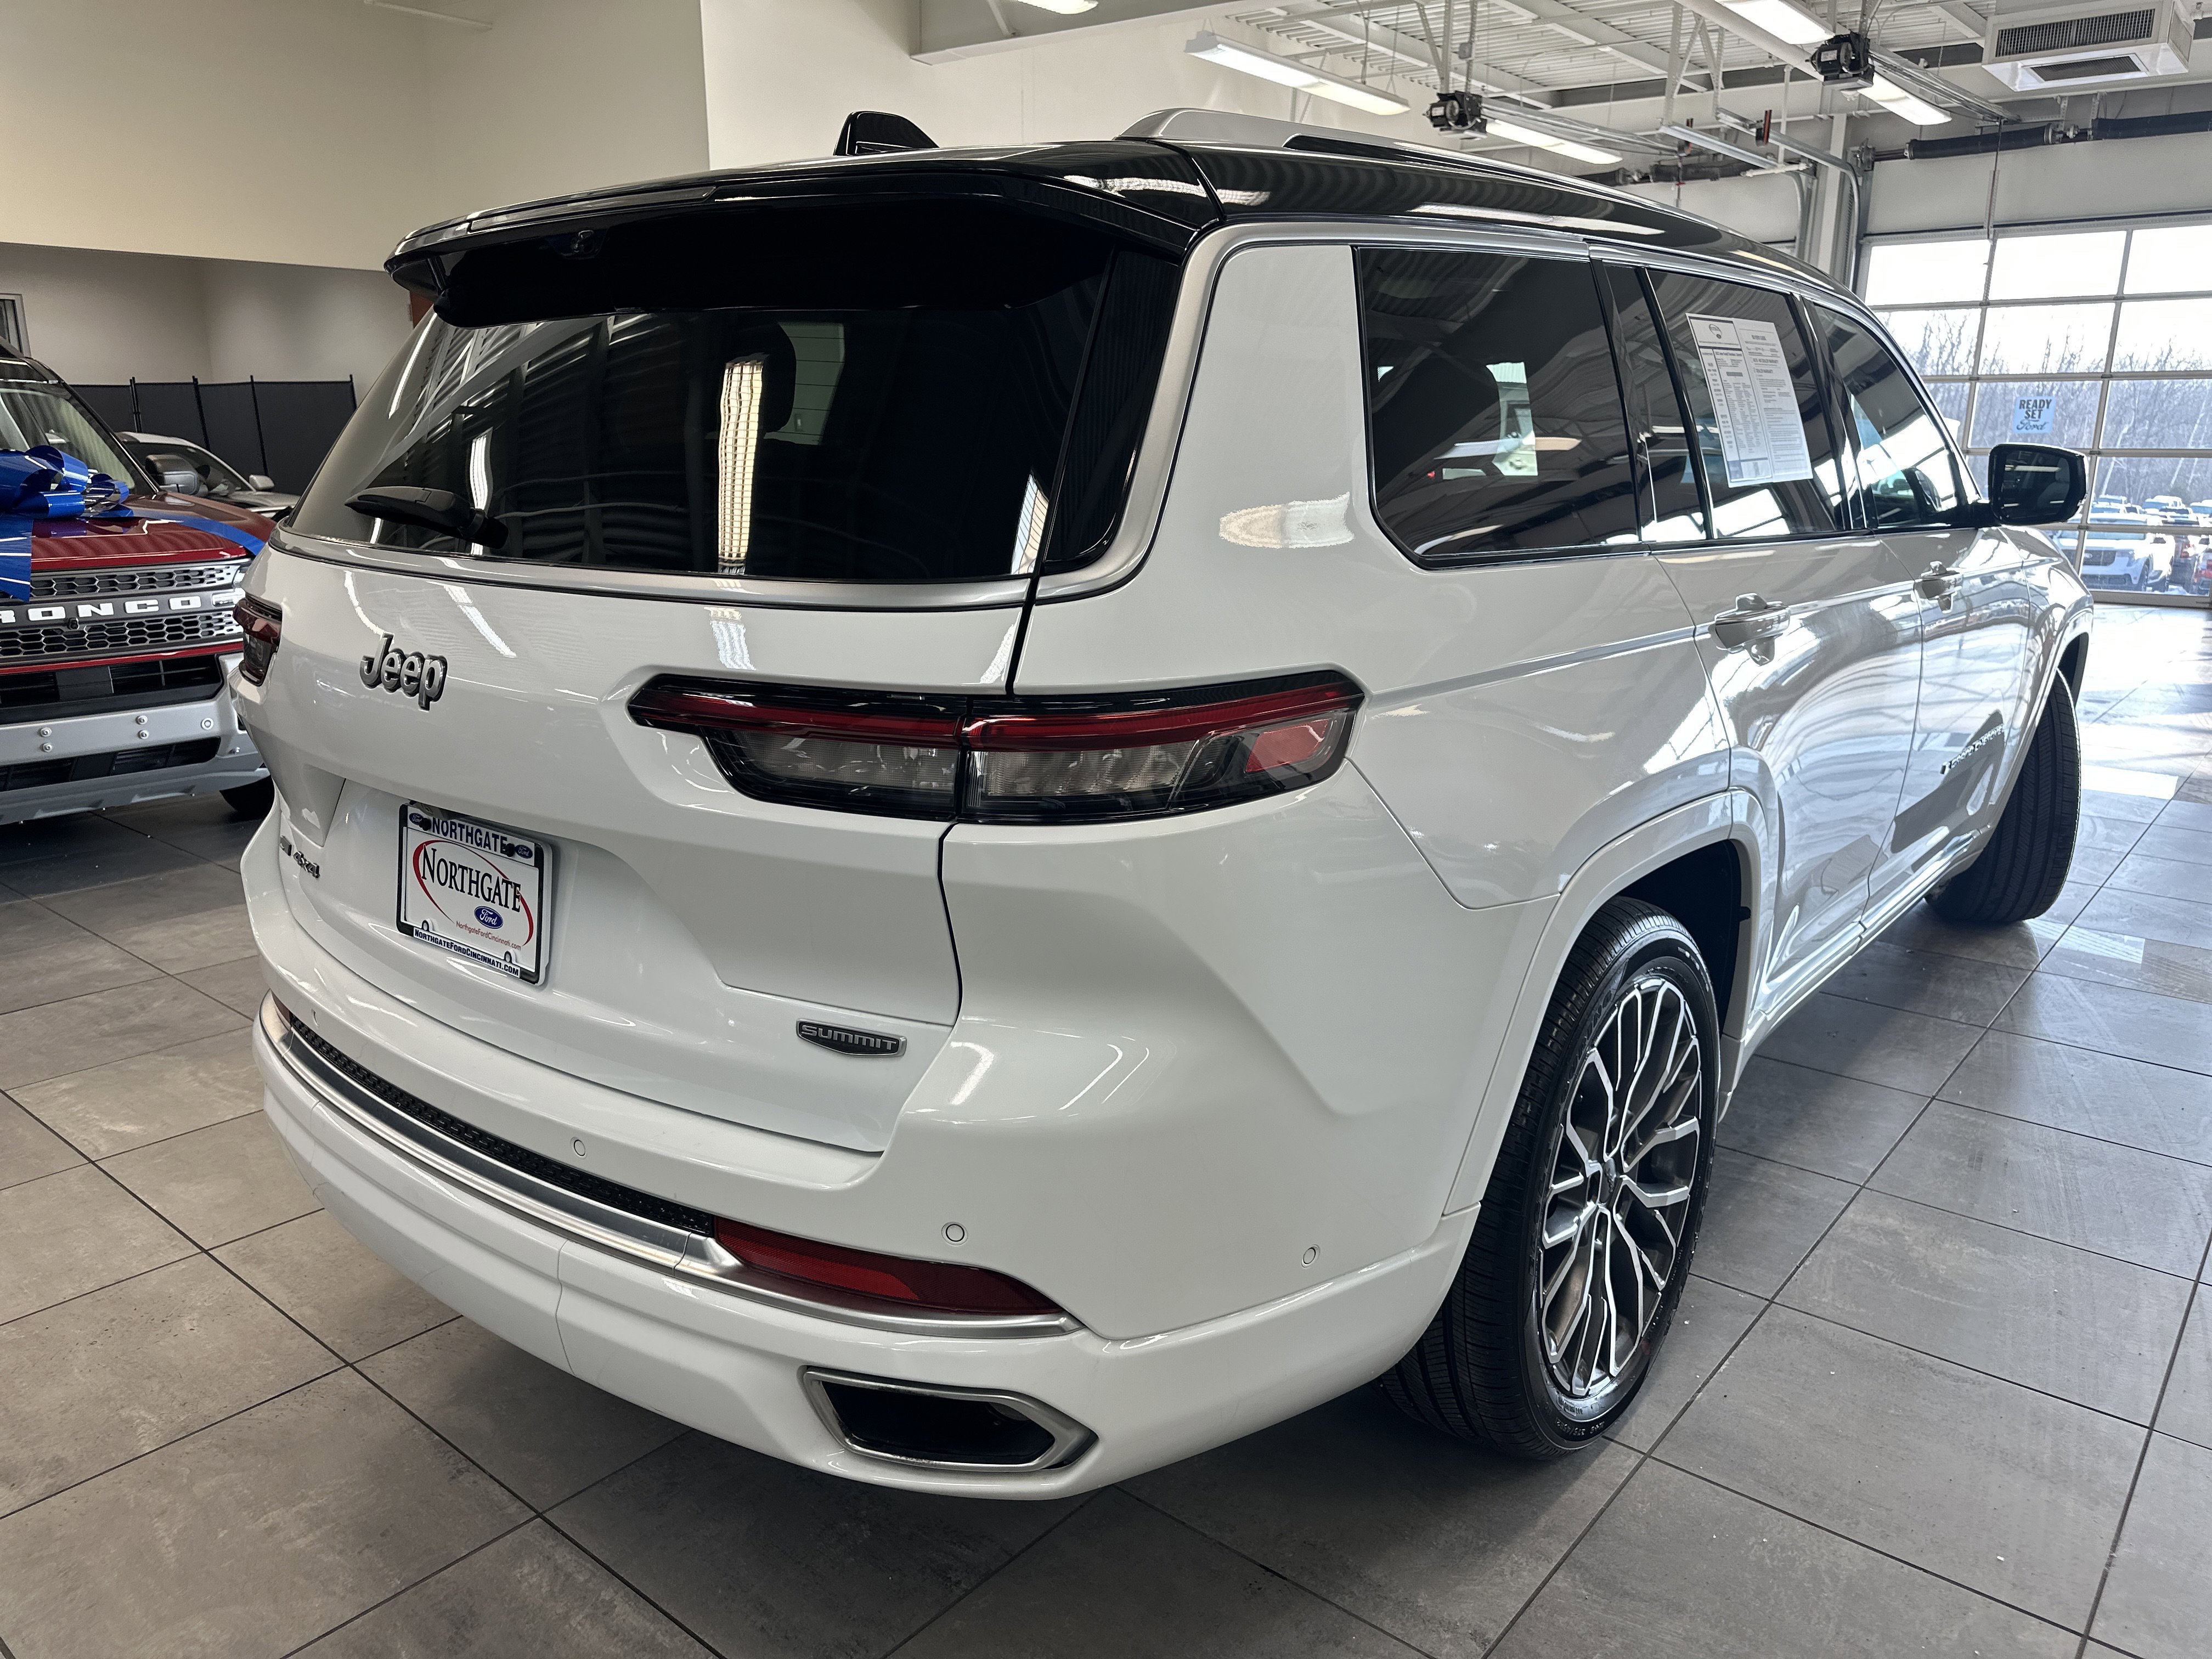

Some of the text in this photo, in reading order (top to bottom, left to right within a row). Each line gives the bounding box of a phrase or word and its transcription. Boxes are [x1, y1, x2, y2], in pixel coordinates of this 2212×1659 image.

[2019, 399, 2052, 409] READY
[2024, 409, 2042, 419] SET
[2016, 419, 2049, 431] Ford
[359, 632, 448, 711] Jeep
[432, 817, 507, 855] NORTHGATE
[517, 845, 531, 857] Ford
[421, 844, 521, 912] NORTHGATE
[477, 907, 500, 927] Ford
[456, 921, 521, 951] NorthgateFordCincinnati.com
[801, 1025, 897, 1050] SUMMIT
